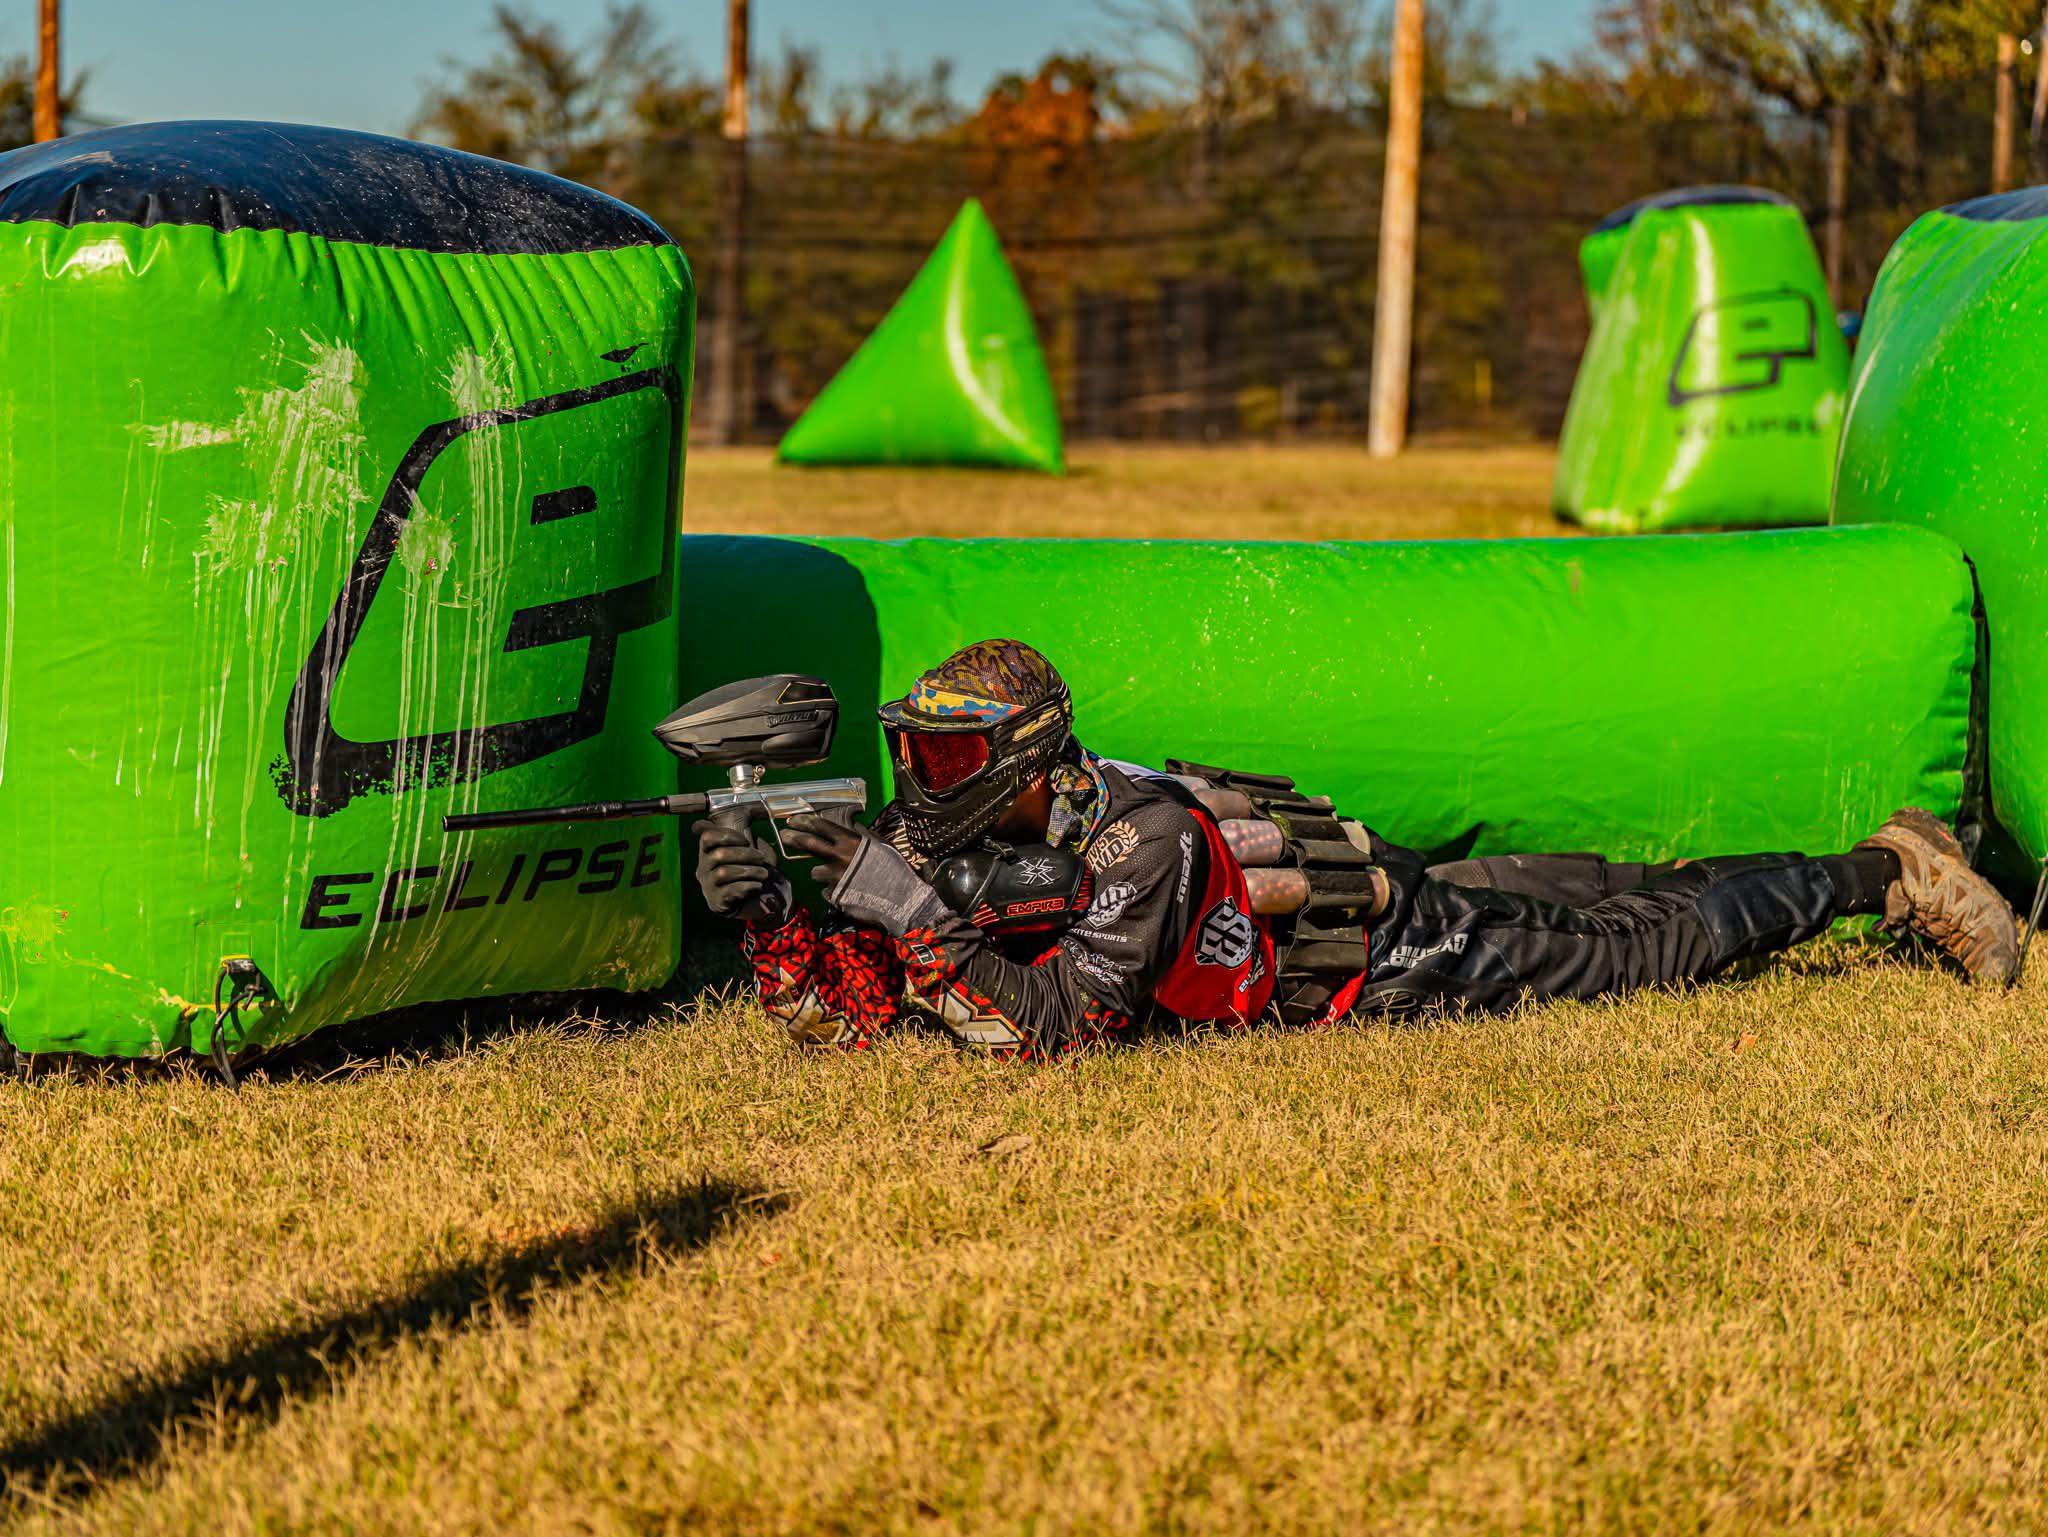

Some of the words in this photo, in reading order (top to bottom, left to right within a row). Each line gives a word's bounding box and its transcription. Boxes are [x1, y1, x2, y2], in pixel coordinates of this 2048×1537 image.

[300, 832, 664, 930] ECLIPSE
[1006, 898, 1065, 916] EMPIRE
[1092, 931, 1128, 943] SPORTS
